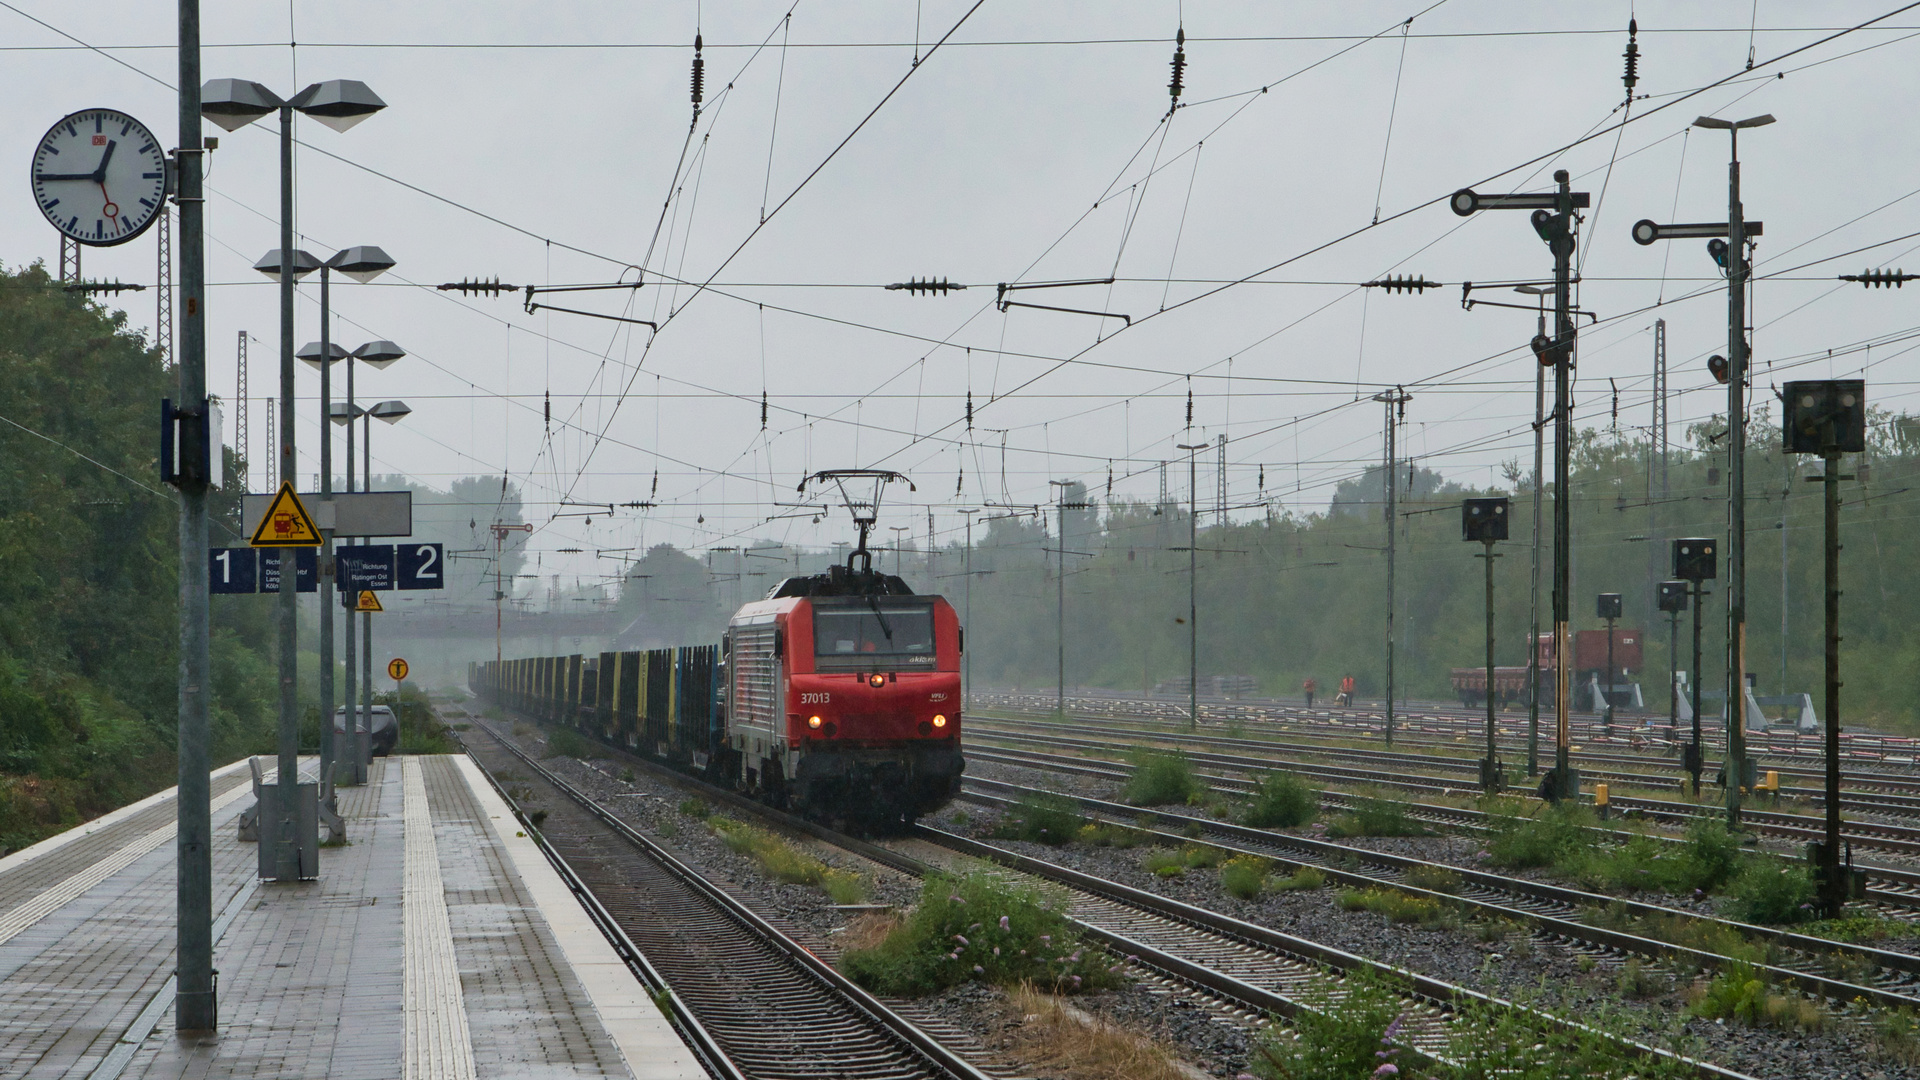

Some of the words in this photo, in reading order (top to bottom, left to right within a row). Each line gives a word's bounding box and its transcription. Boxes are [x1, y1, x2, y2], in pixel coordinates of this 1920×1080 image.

[93, 136, 105, 145] DB
[216, 550, 229, 583] 1
[362, 563, 388, 571] Richtung
[416, 545, 438, 578] 2
[801, 692, 830, 704] 37013
